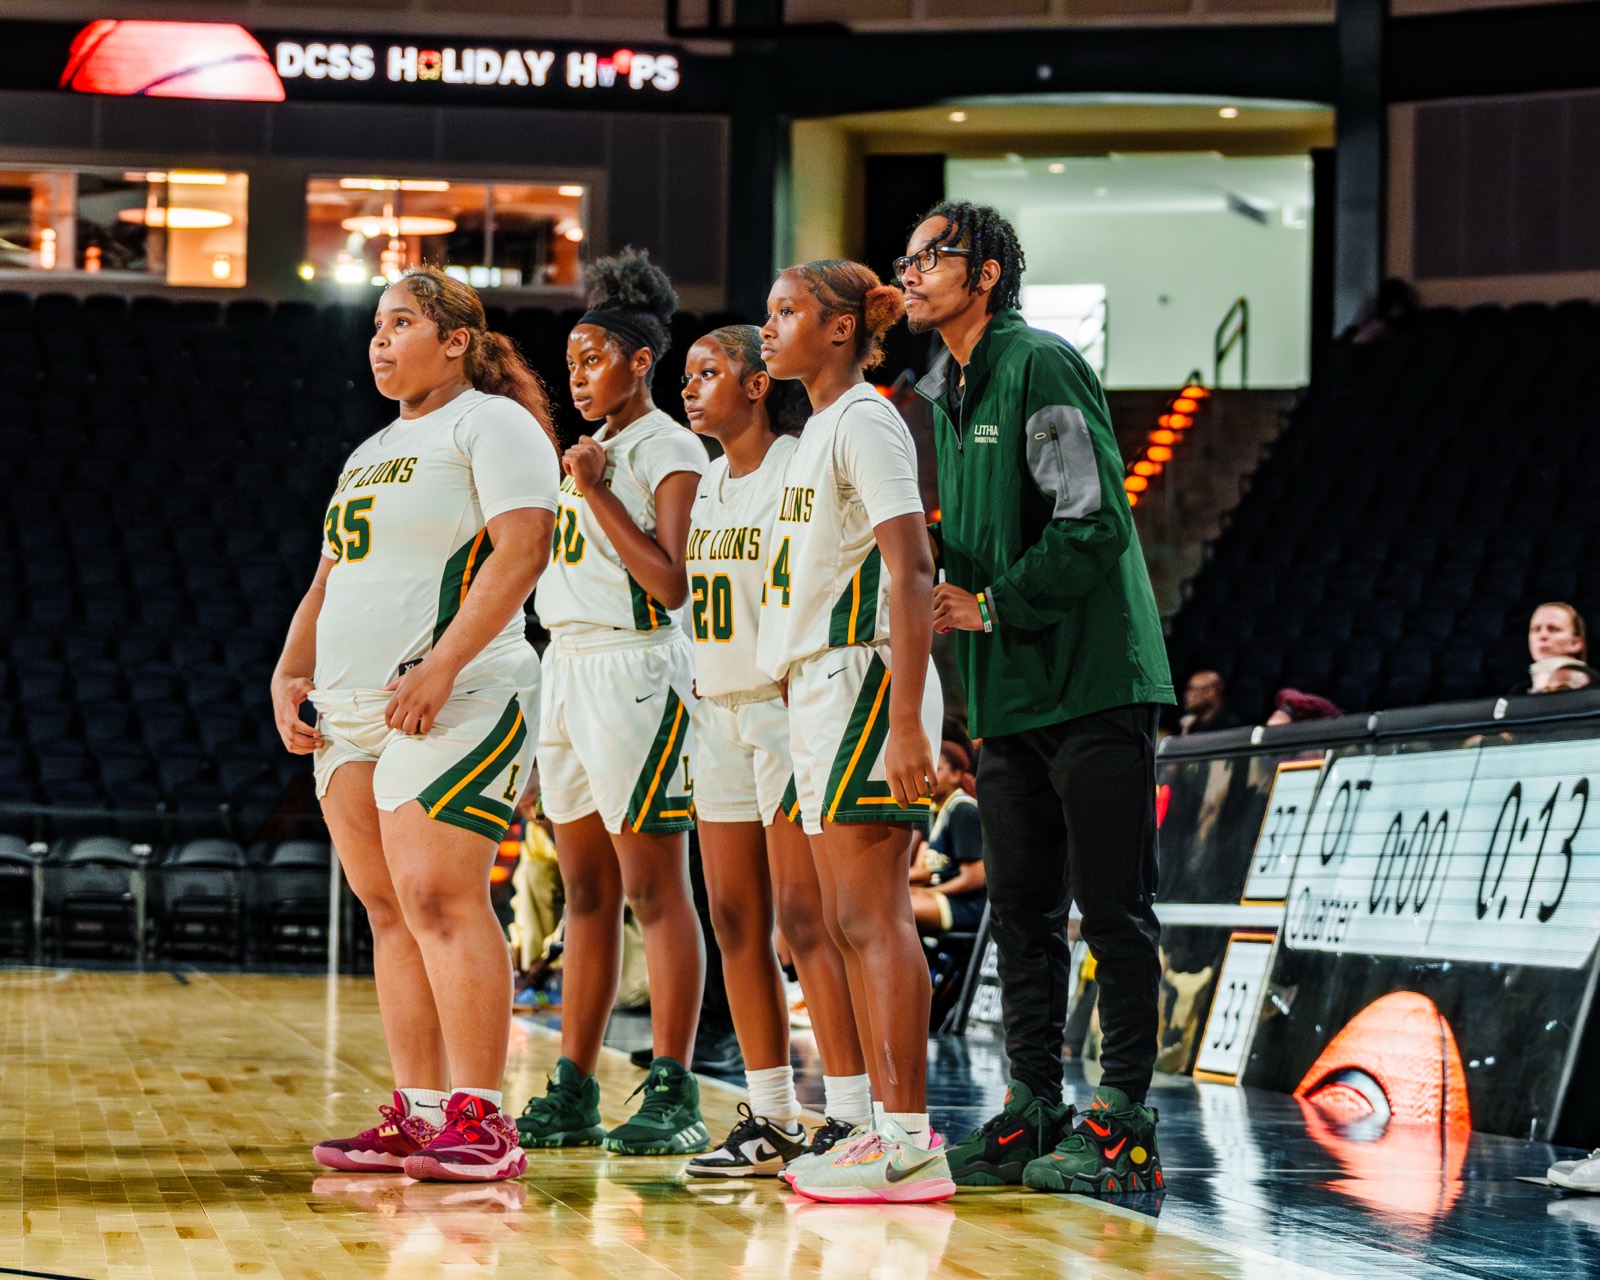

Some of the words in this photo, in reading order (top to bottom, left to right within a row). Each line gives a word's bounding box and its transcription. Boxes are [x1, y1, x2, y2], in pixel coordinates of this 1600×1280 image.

[276, 41, 375, 81] DCSS
[387, 46, 555, 87] HOLIDAY
[354, 457, 418, 489] LIONS
[325, 495, 376, 567] 35
[709, 526, 761, 562] LIONS
[761, 535, 791, 608] 4
[691, 572, 735, 643] 20
[501, 763, 521, 803] L
[1477, 777, 1589, 923] 0:13
